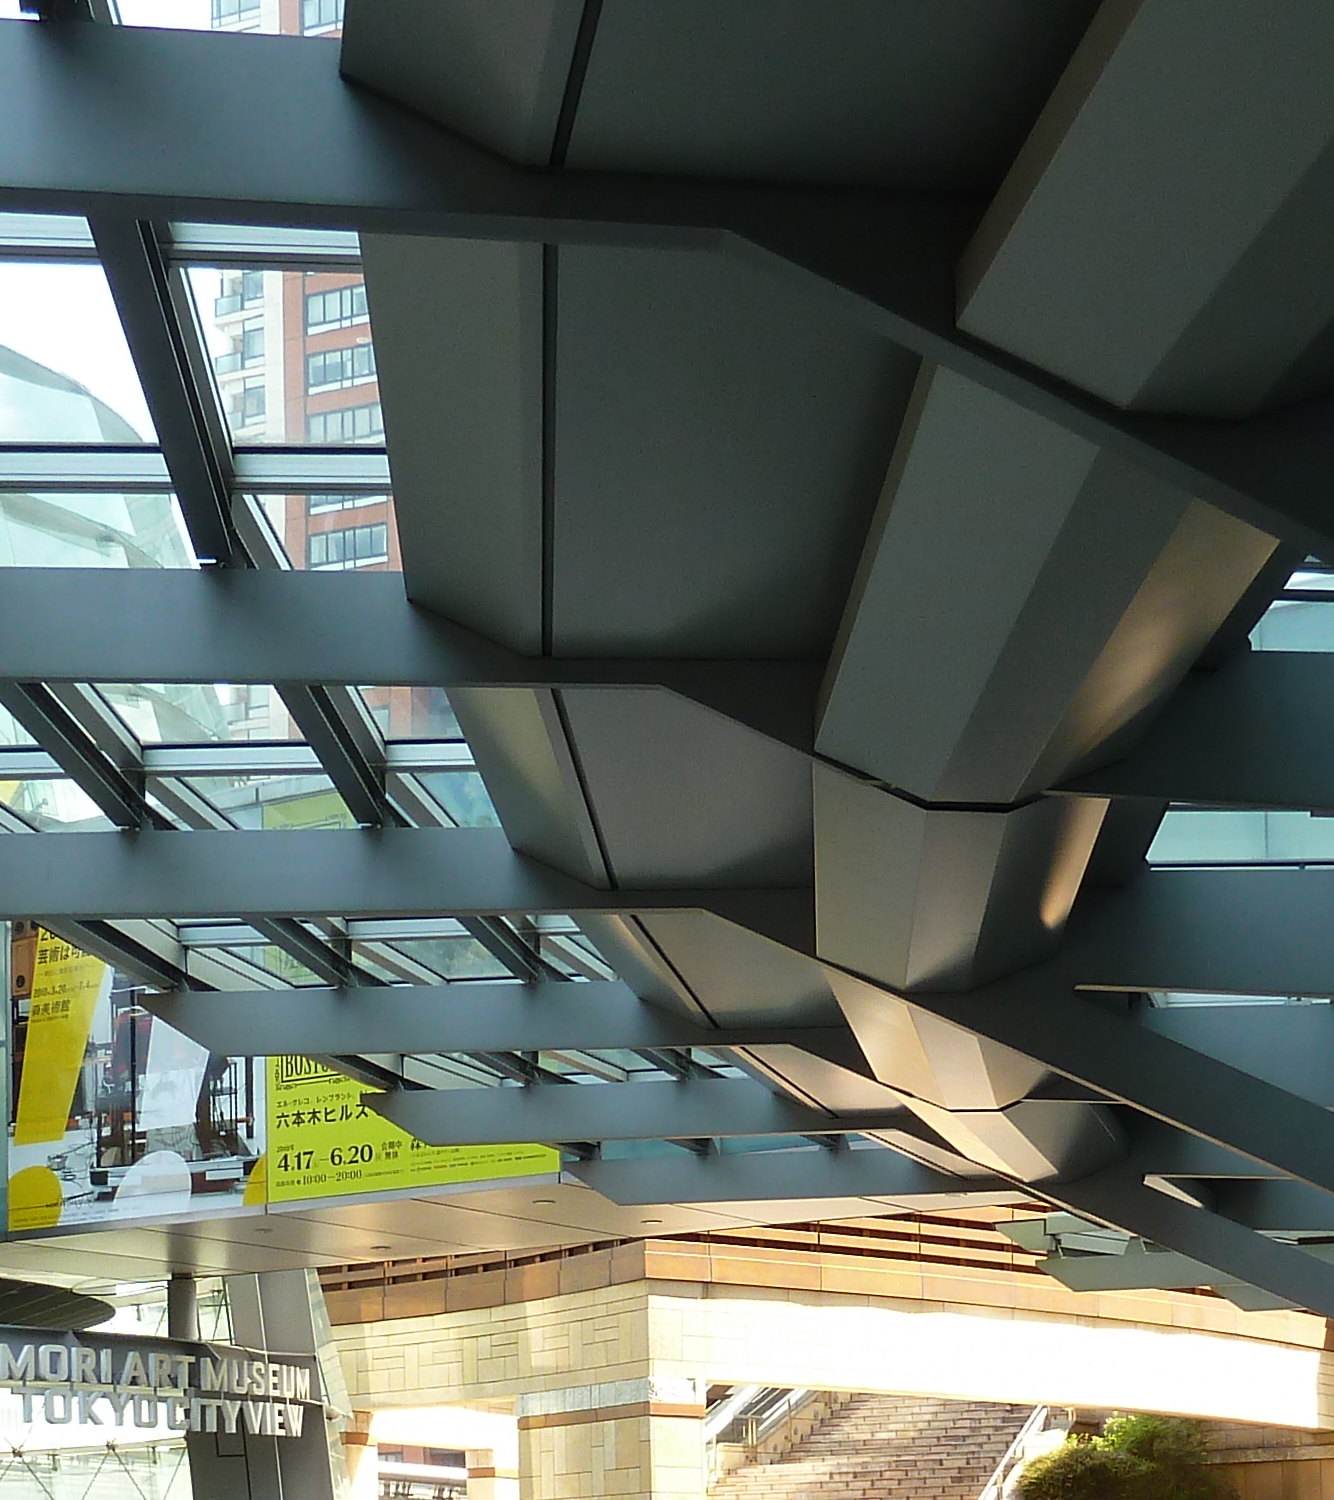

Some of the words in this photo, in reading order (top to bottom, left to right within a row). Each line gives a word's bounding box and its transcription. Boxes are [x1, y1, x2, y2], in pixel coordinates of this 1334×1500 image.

[37, 946, 83, 965] 芸術は可
[277, 1150, 315, 1172] 4.17
[330, 1144, 374, 1166] 6.20
[119, 1349, 196, 1391] ART
[200, 1355, 311, 1402] MUSEUM
[15, 1386, 158, 1429] TOKYO
[167, 1396, 241, 1434] CITY
[241, 1400, 305, 1438] VIEW
